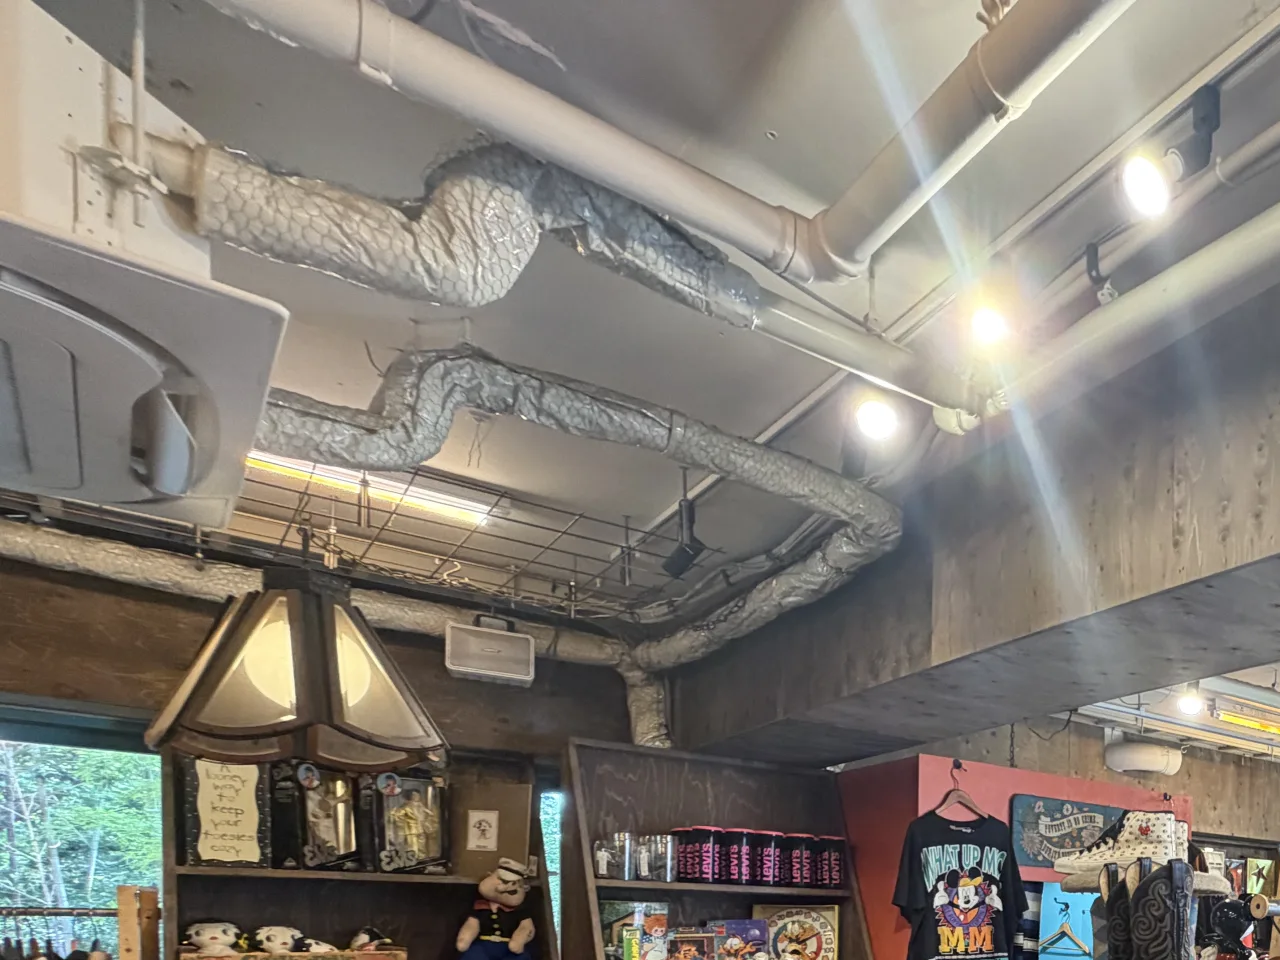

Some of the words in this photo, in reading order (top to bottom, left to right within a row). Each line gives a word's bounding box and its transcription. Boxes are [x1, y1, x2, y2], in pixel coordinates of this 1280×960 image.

[210, 801, 245, 819] keep
[921, 844, 960, 893] WHAT
[961, 844, 981, 871] UP
